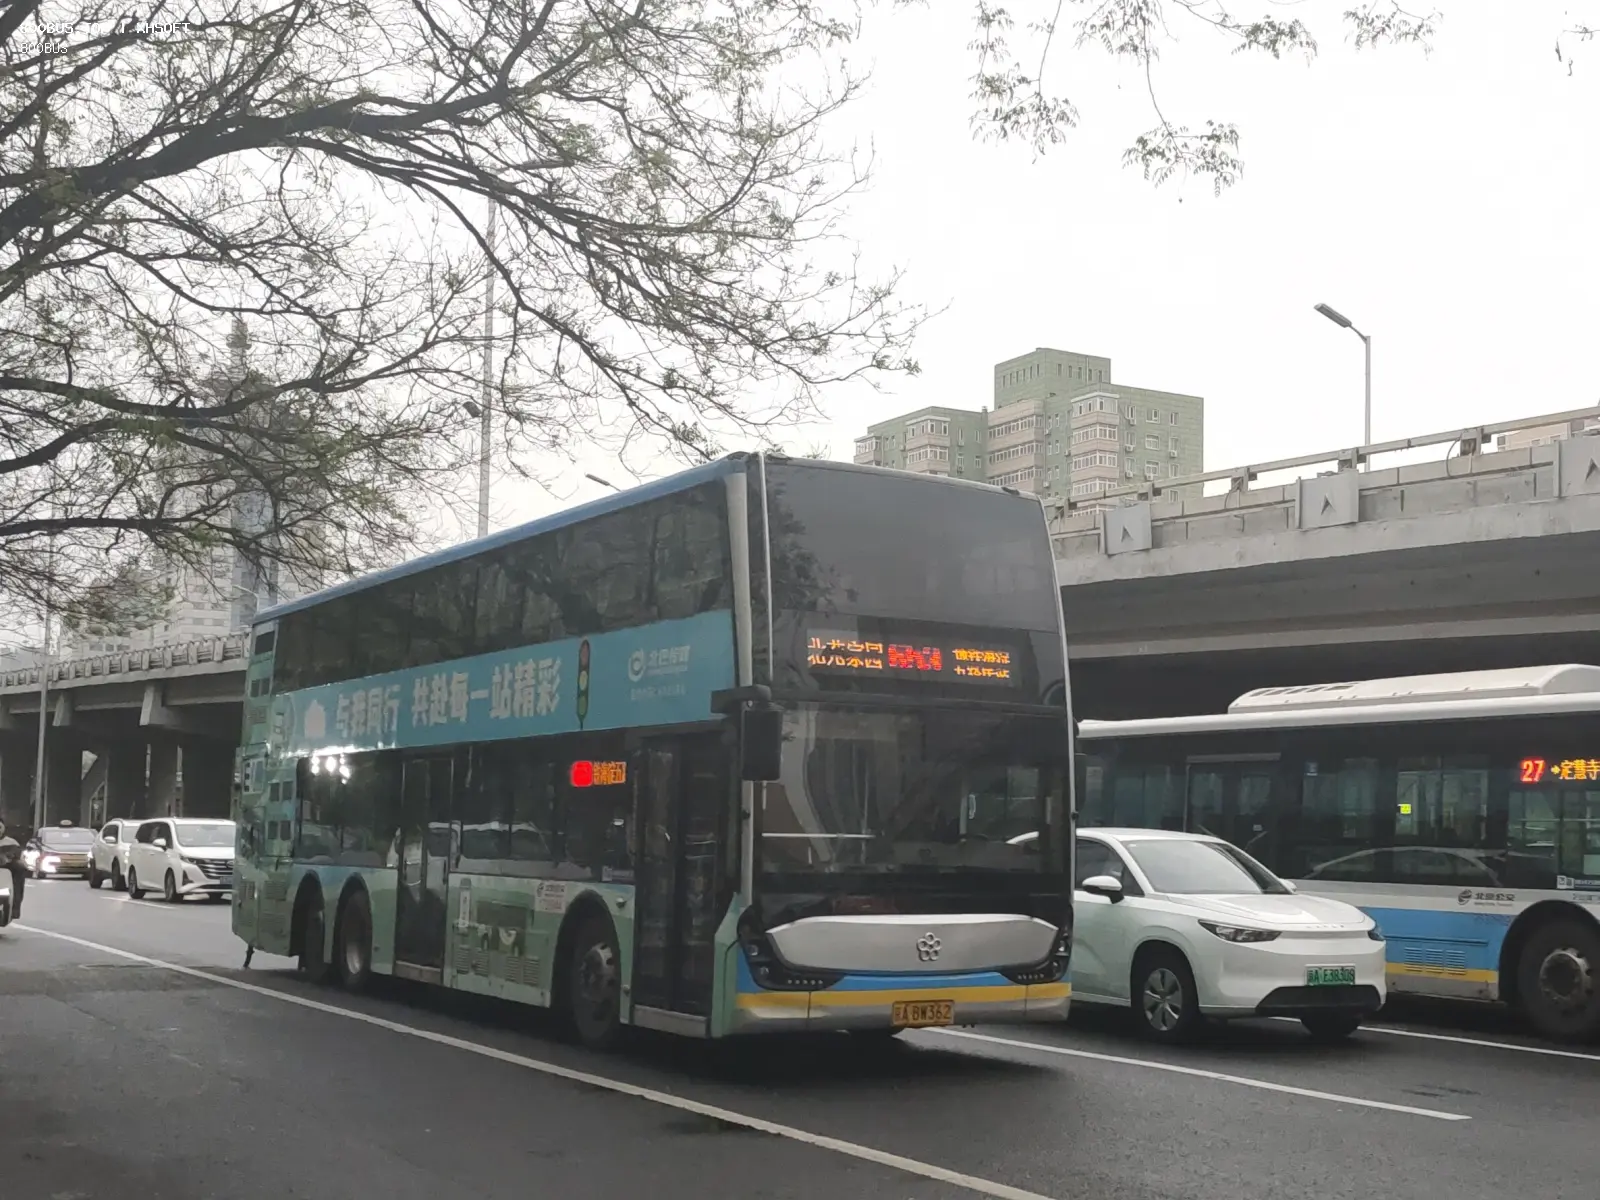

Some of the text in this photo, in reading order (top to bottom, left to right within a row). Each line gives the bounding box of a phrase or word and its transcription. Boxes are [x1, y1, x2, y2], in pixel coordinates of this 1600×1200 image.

[1521, 759, 1546, 782] 27
[1559, 759, 1600, 781] 定慧寺
